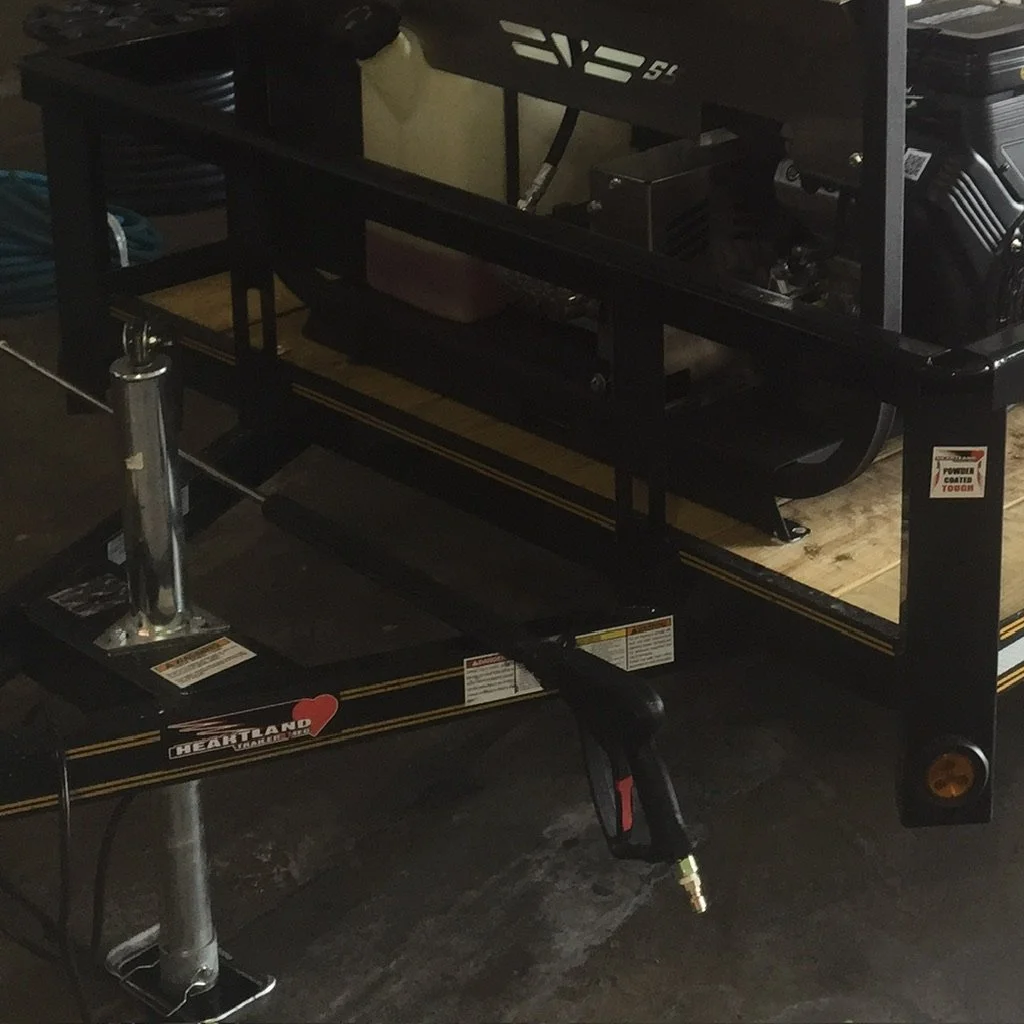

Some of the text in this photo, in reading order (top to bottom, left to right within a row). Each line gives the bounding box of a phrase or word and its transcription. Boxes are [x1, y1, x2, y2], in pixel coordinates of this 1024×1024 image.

[943, 467, 974, 475] POWDER
[944, 476, 973, 484] COATED
[942, 484, 974, 493] TOUGH
[175, 719, 312, 756] HEARTLAND
